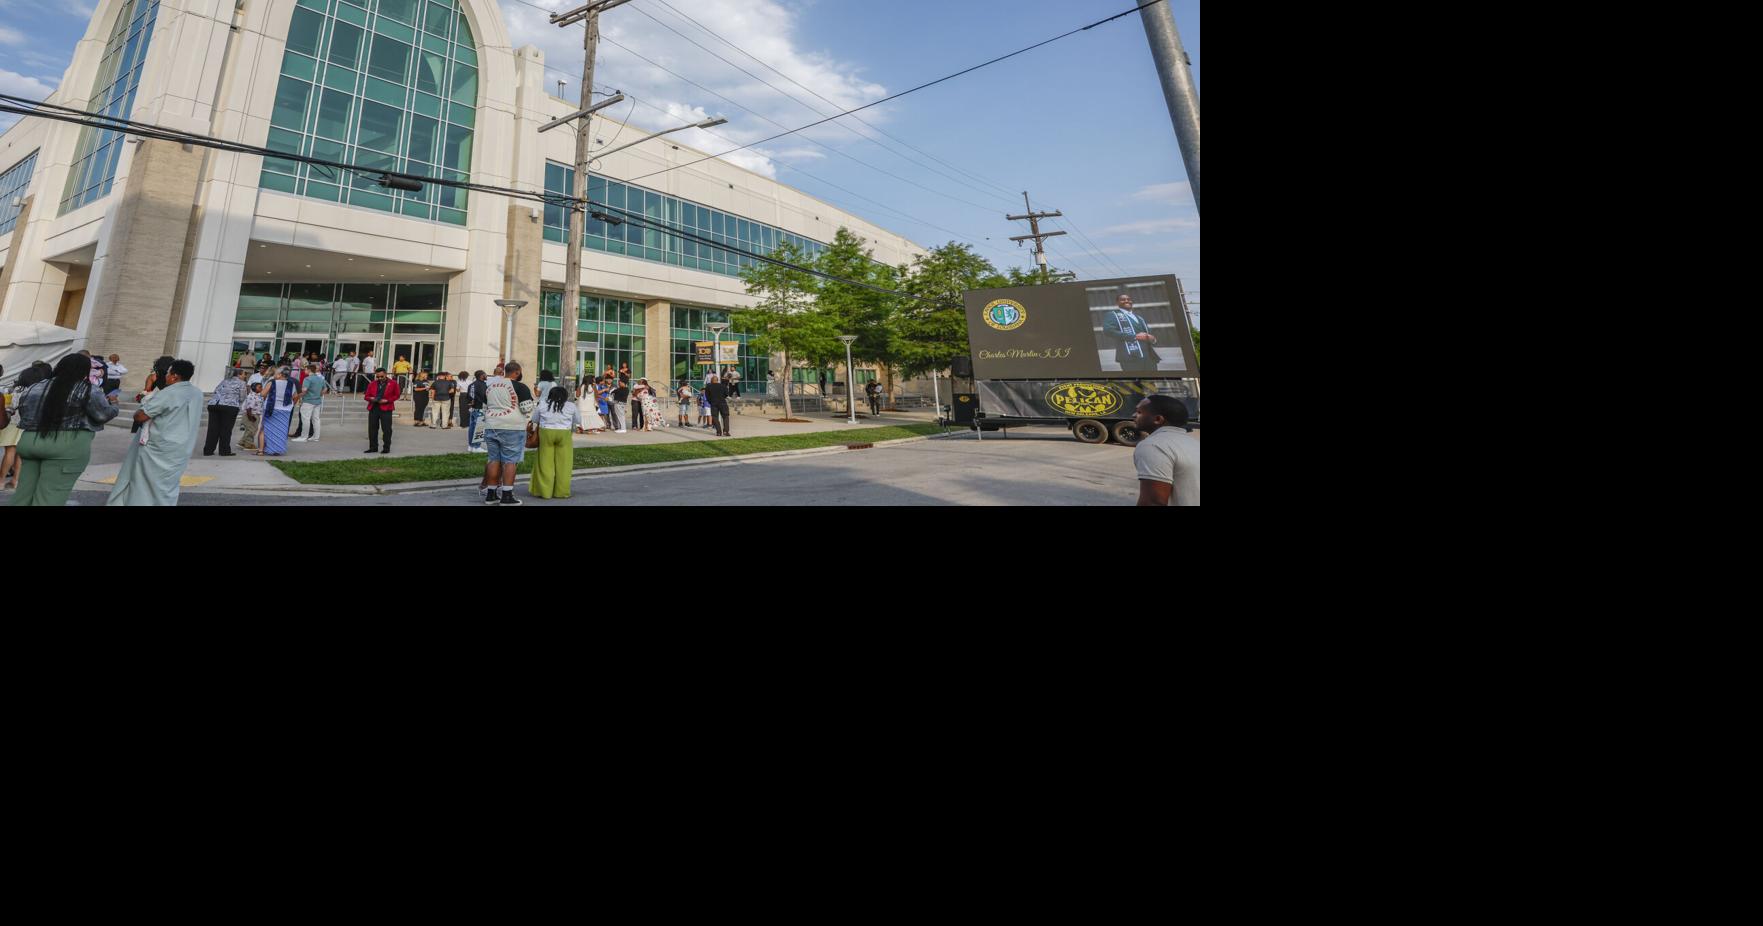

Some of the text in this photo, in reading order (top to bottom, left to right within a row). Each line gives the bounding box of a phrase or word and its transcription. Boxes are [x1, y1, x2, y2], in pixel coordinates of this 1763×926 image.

[979, 349, 1006, 359] Charles
[1007, 348, 1038, 359] Martin
[1055, 394, 1112, 405] PELICAN
